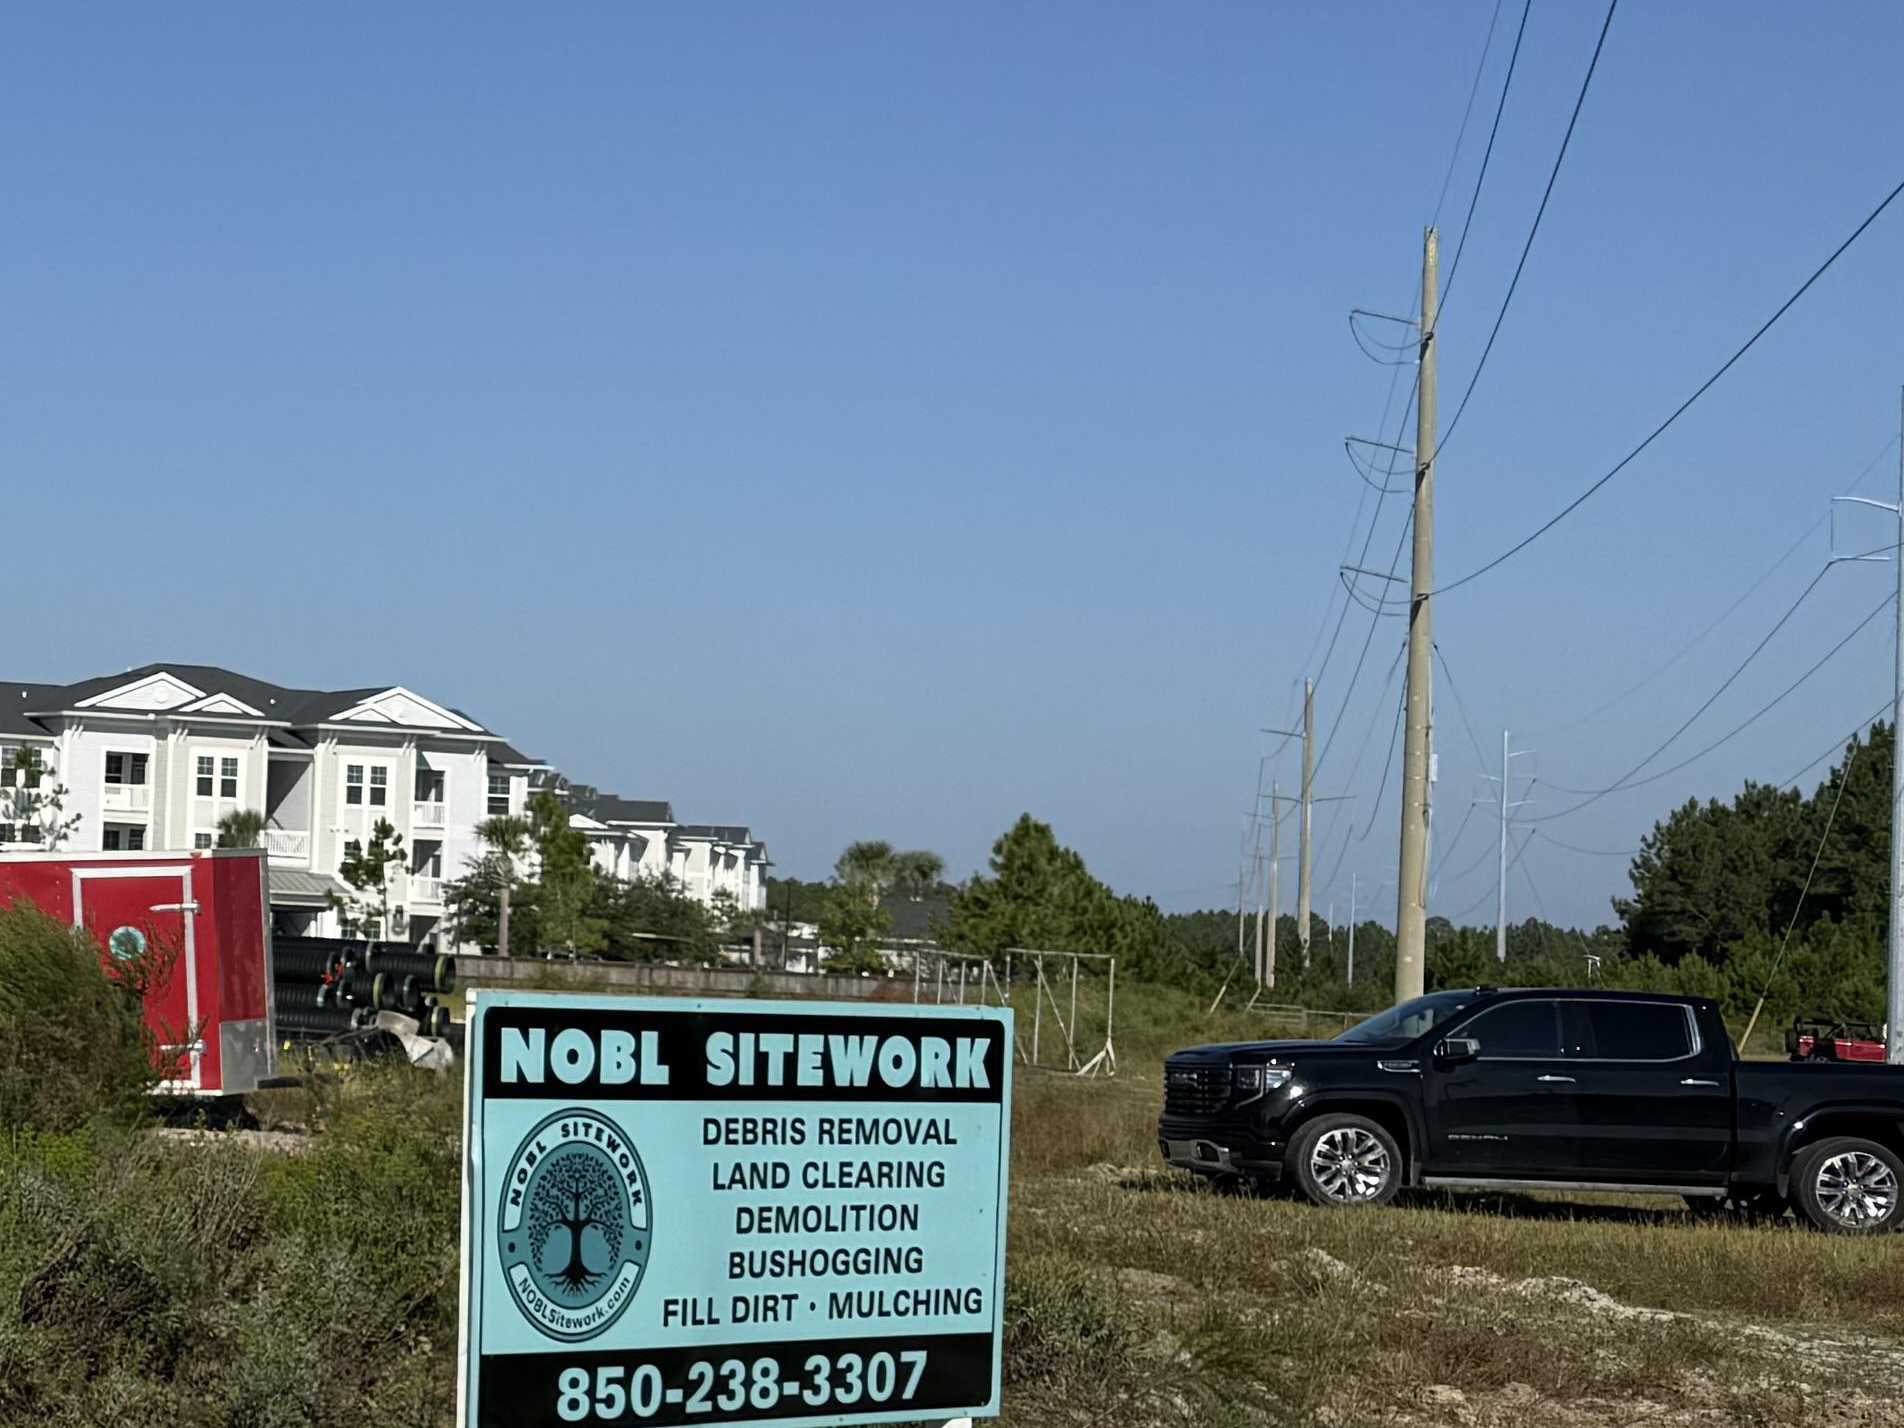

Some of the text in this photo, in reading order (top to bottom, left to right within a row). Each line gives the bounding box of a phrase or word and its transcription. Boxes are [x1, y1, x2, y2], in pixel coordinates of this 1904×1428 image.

[500, 1027, 991, 1088] NOBL SITEWORK
[703, 1118, 958, 1146] DEBRIS REMOVAL
[510, 1121, 643, 1208] NOBL SITEWORK
[712, 1161, 946, 1191] LAND CLEARING
[735, 1204, 919, 1235] DEMOLITION
[728, 1247, 924, 1279] BUSHOGGING
[518, 1275, 631, 1330] NOBLSitework.com
[663, 1288, 983, 1327] FILL DIRT MULCHING
[556, 1350, 928, 1422] 850-238-3307
